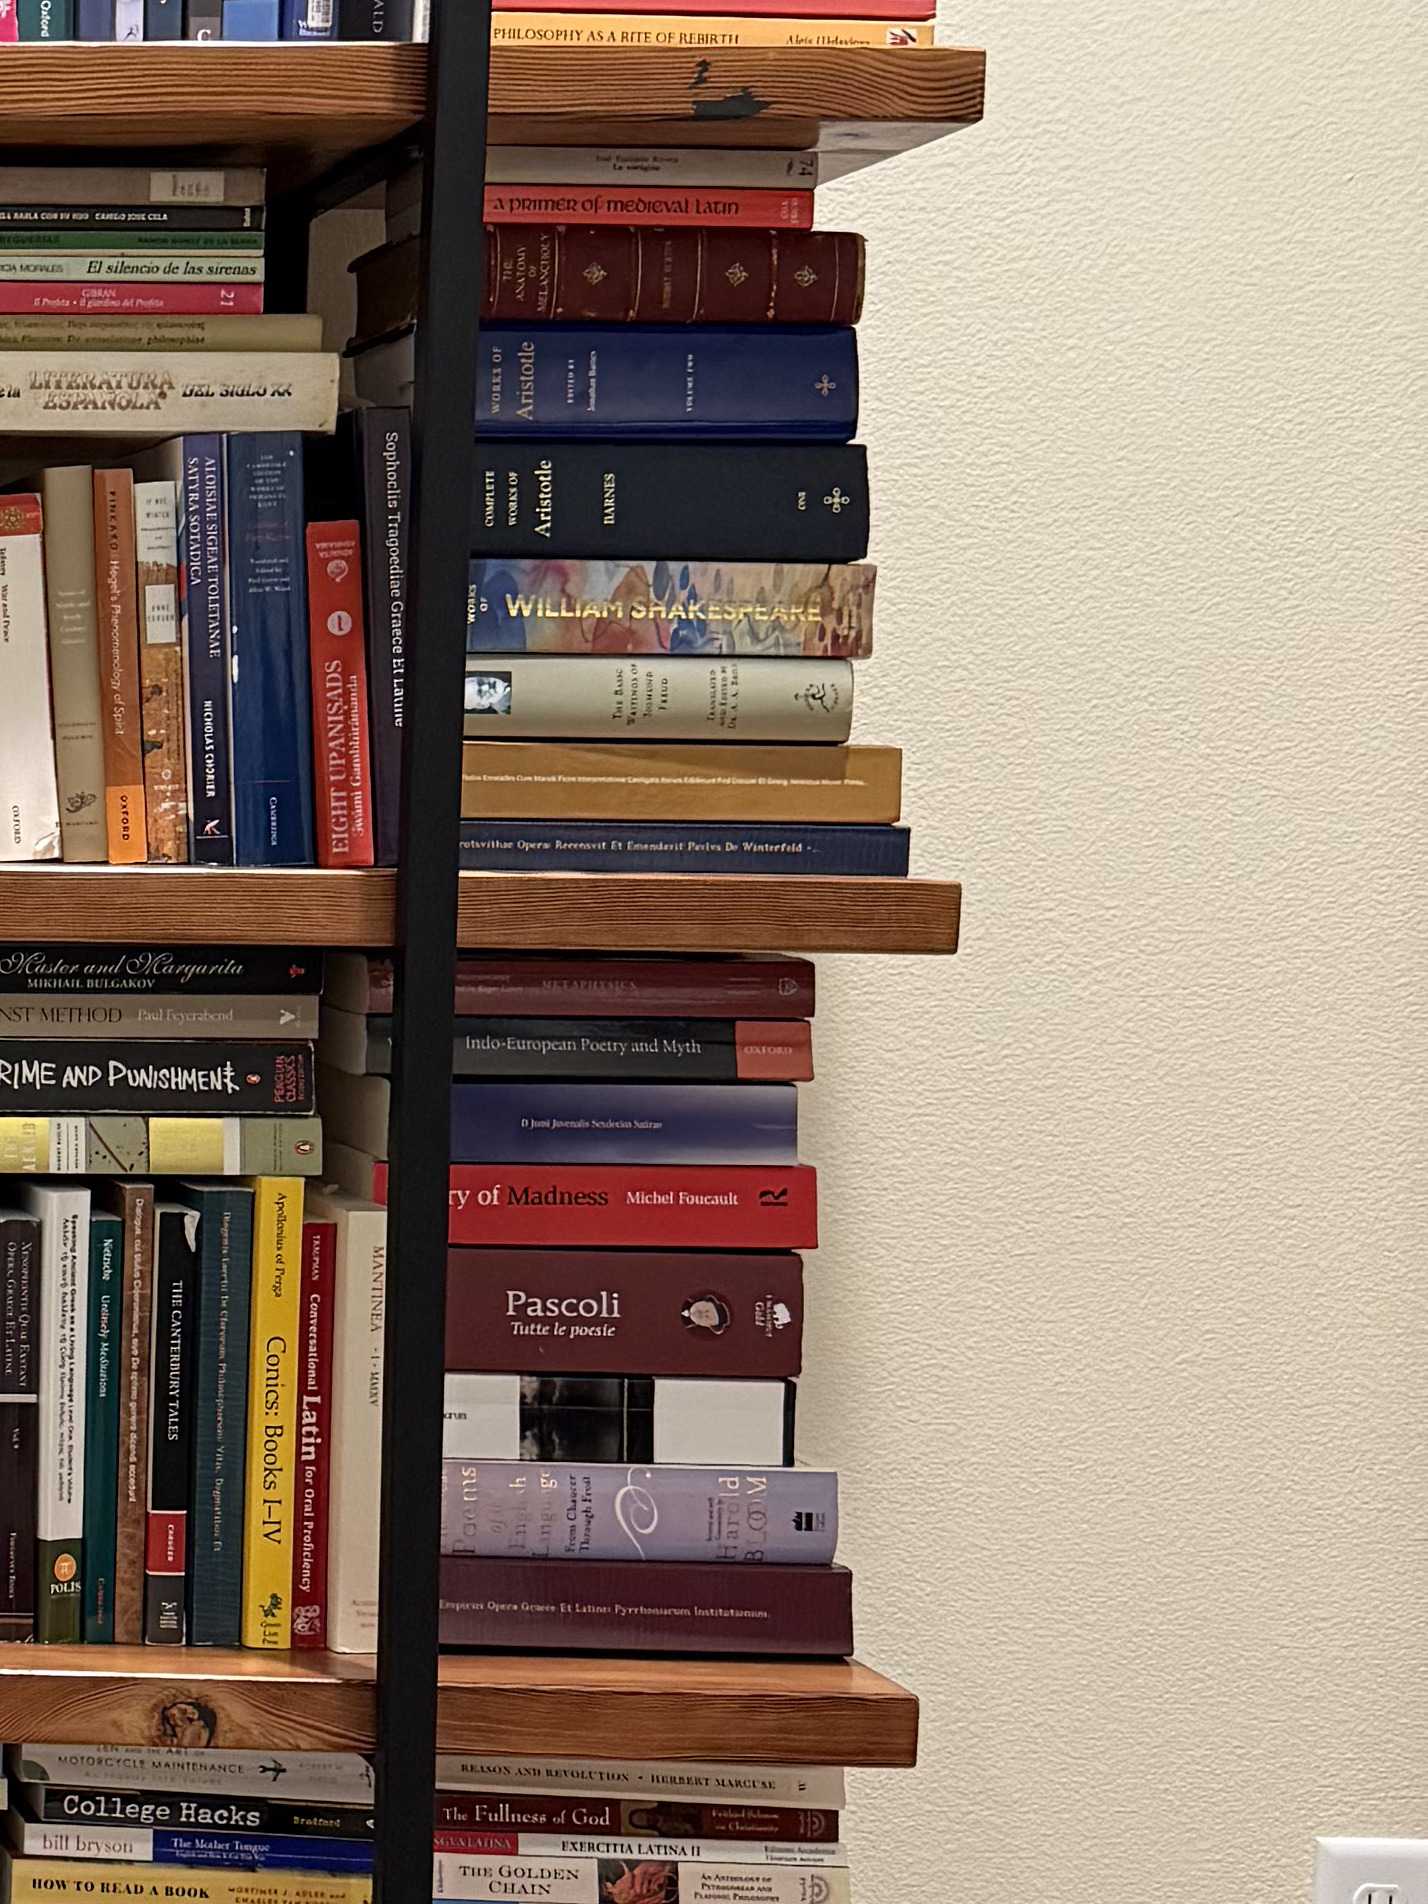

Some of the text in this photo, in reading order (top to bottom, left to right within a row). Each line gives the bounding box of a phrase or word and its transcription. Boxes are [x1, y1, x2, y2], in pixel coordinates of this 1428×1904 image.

[86, 260, 257, 277] El silencio de las sirenas
[534, 459, 552, 538] Aristotle
[507, 595, 823, 622] WILLIAM SHAKESPEARE
[28, 977, 155, 990] MIKHAIL BULGAKOV
[62, 1065, 102, 1094] AND
[626, 1190, 739, 1206] Michel Foucault
[506, 1290, 621, 1318] Pascoli
[511, 1321, 615, 1339] Tutte le poesie
[263, 1336, 288, 1417] Conics:
[263, 1425, 286, 1490] Books
[63, 1795, 260, 1827] College Hacks
